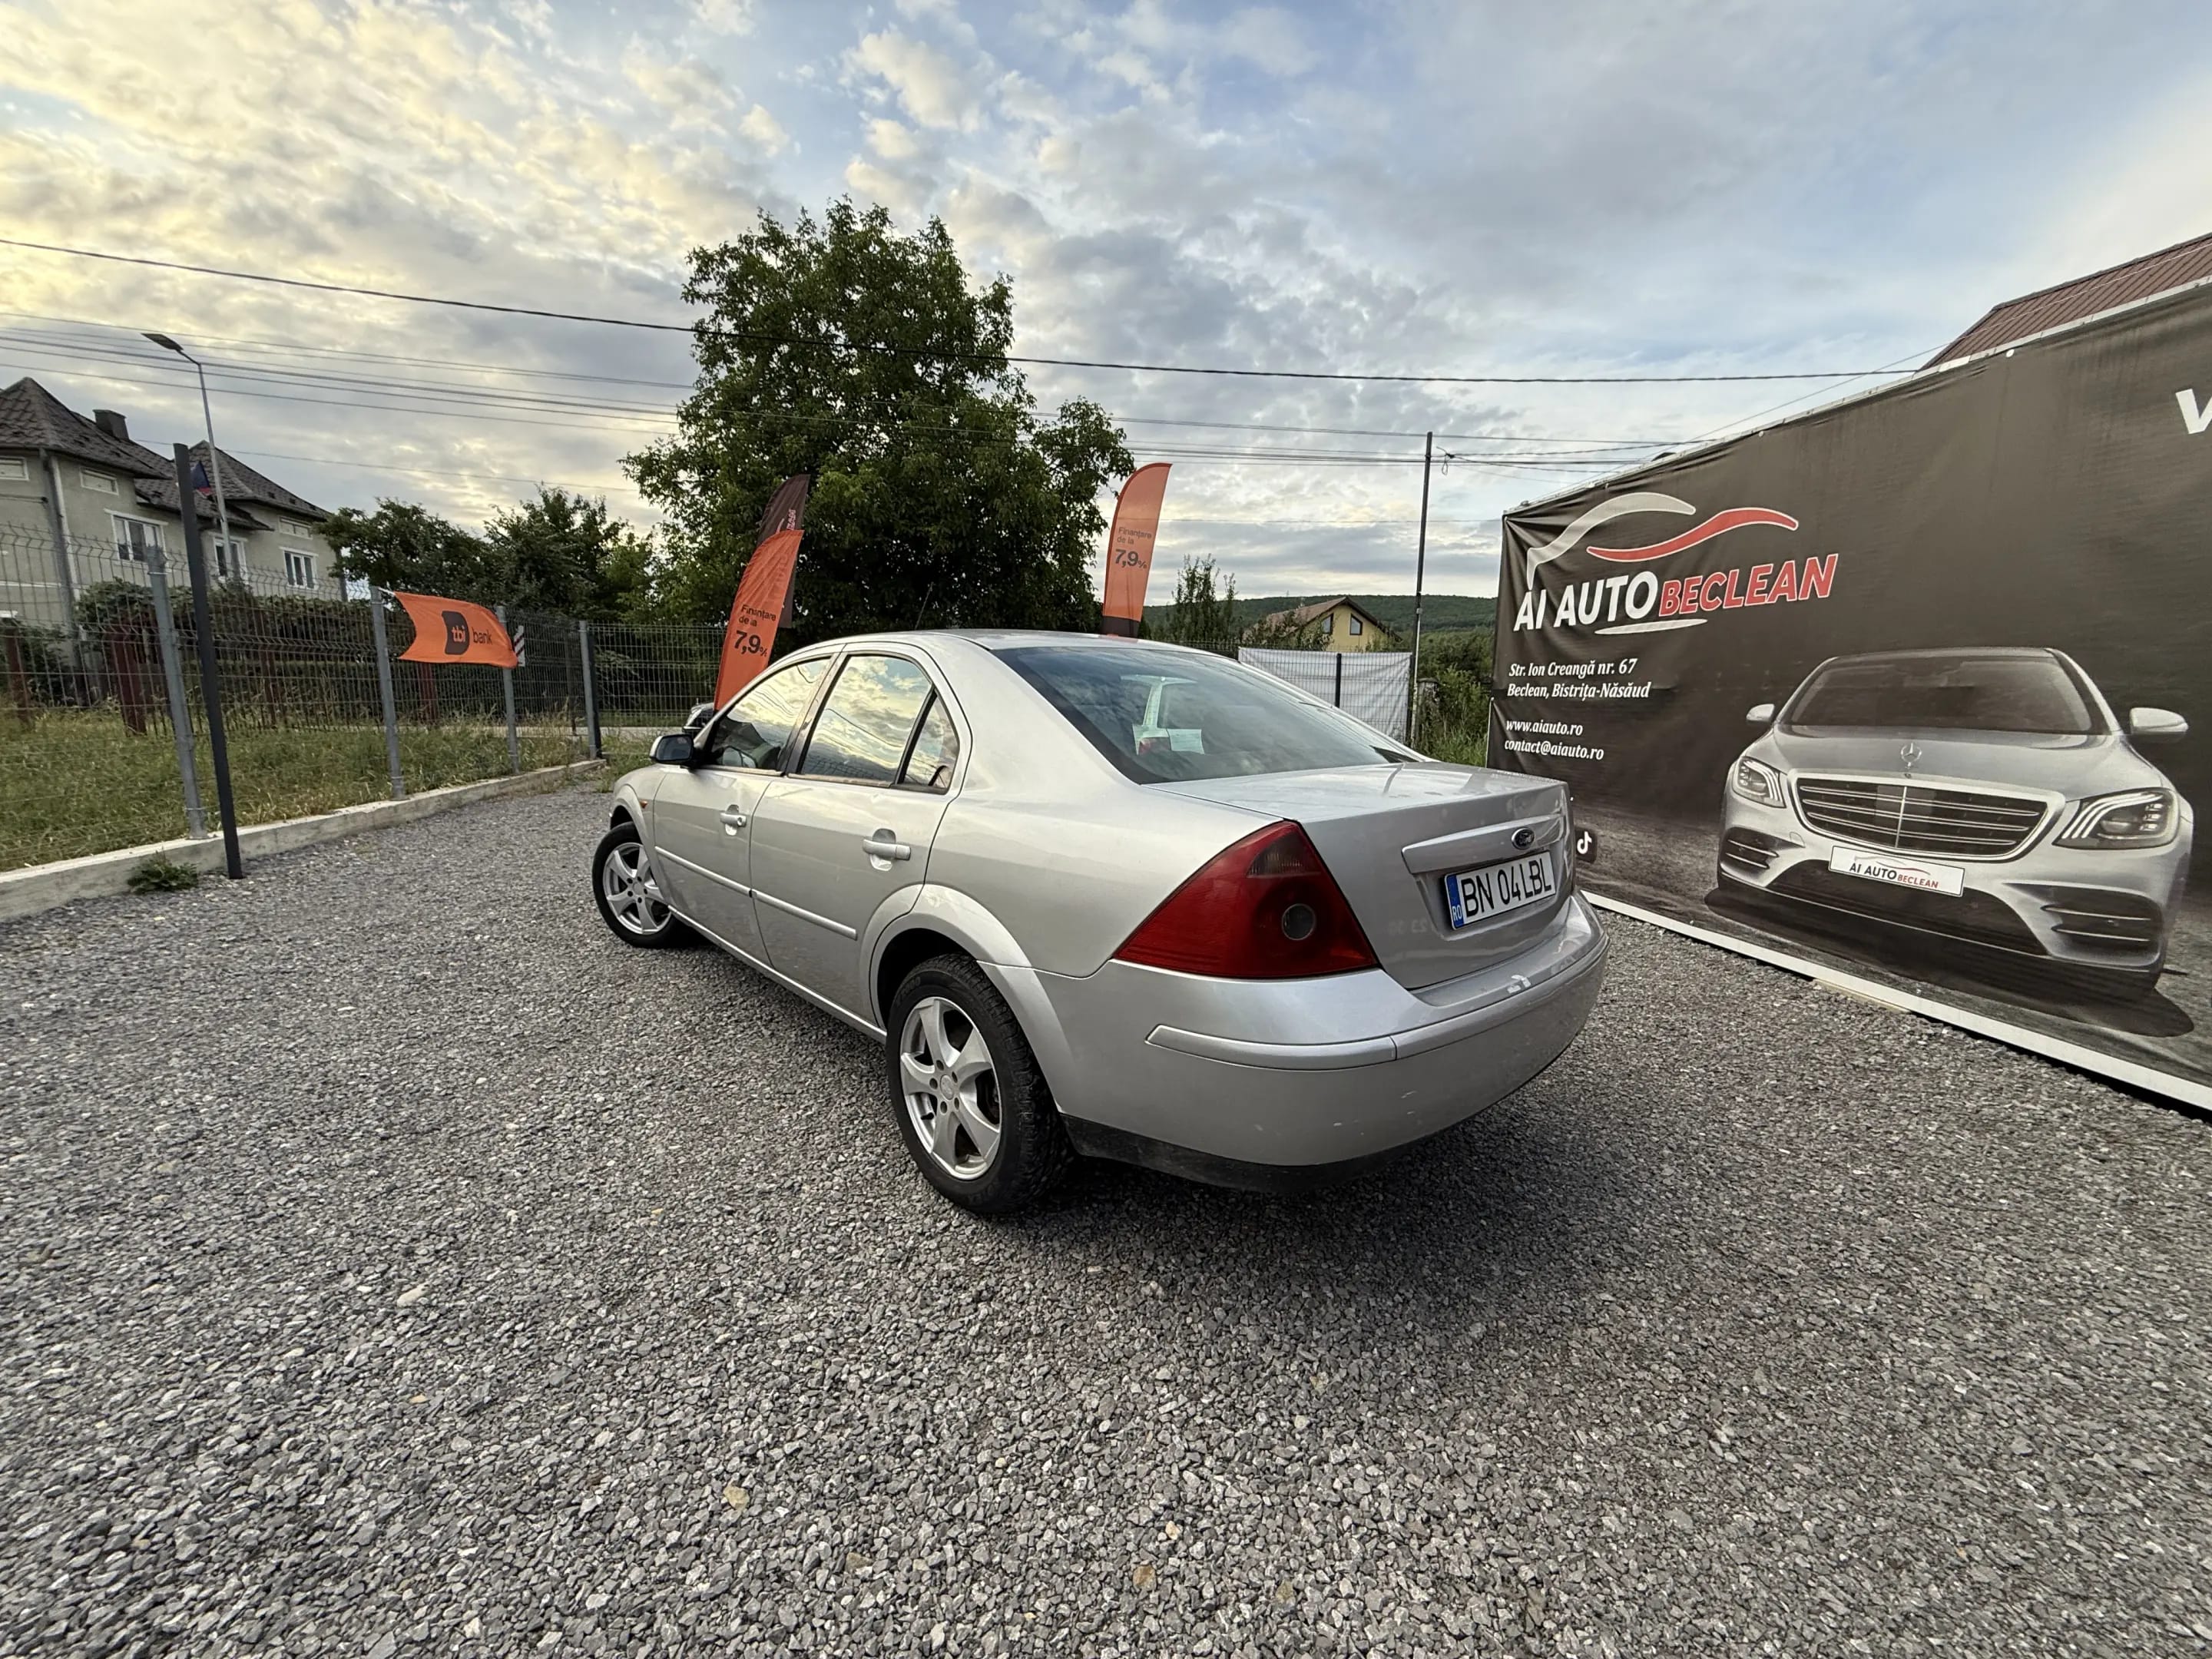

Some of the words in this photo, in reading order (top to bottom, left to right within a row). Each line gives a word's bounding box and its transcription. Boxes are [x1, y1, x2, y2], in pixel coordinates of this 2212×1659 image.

[1115, 548, 1147, 569] 7,9%
[1513, 586, 1546, 631] AI
[1553, 571, 1658, 628] AUTO
[1658, 553, 1839, 617] BECLEAN
[738, 615, 750, 624] de
[452, 624, 466, 642] tbi
[472, 627, 493, 645] bank
[734, 630, 768, 657] 7,9%
[1508, 663, 1526, 677] Str.
[1528, 663, 1545, 676] Ion
[1548, 660, 1594, 679] Creangă
[1598, 663, 1615, 675] nr.
[1618, 658, 1637, 674] 67
[1507, 683, 1549, 699] Beclean,
[1505, 719, 1583, 736] www.aiauto.ro
[1504, 739, 1604, 760] contact@aiauto.ro
[1849, 863, 1862, 873] AI
[1864, 866, 1897, 880] AUTO
[1897, 874, 1939, 889] BECLEAN
[1461, 873, 1495, 917] BN
[1452, 905, 1462, 922] RO
